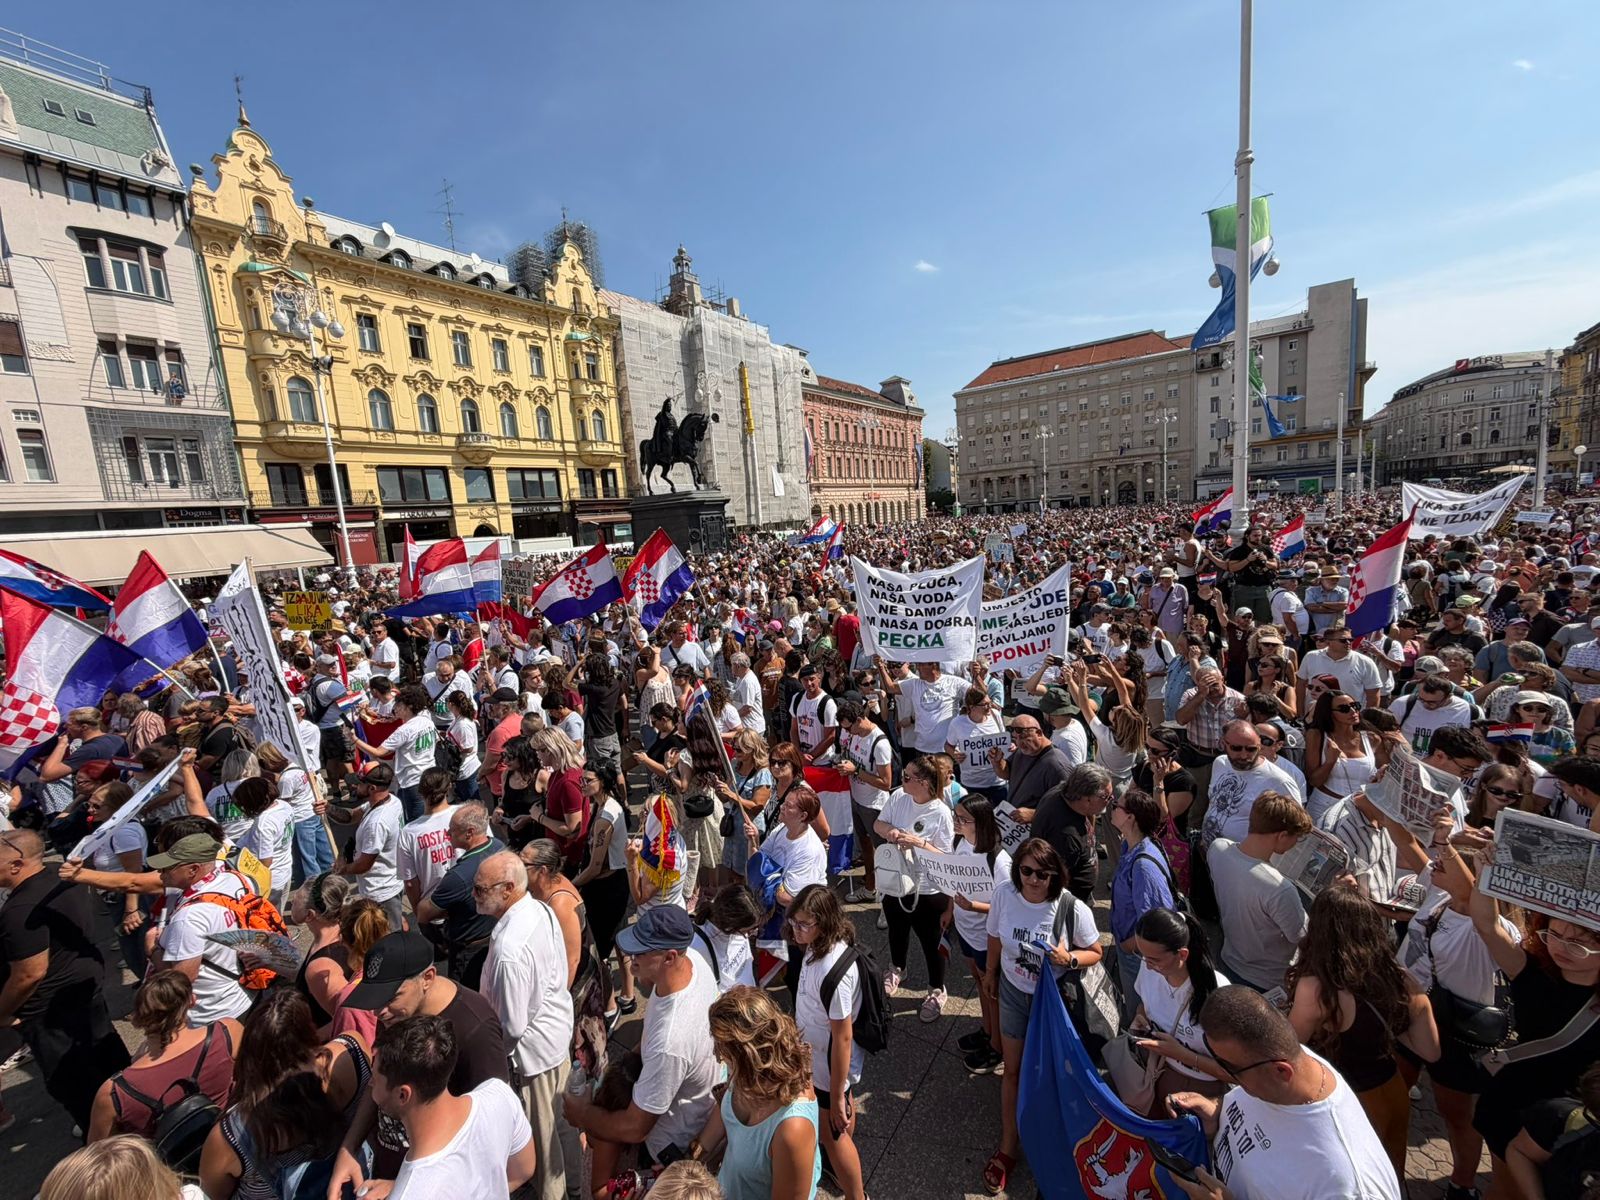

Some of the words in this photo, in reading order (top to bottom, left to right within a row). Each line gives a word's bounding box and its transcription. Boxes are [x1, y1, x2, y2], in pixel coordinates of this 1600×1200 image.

[976, 419, 1038, 435] GRADSKA
[180, 509, 212, 518] Dogma
[1420, 517, 1439, 527] NE
[508, 560, 523, 569] STOP
[870, 588, 907, 604] NAŠA
[296, 604, 323, 616] LIKA
[879, 604, 898, 615] NE
[905, 606, 947, 617] DAMO
[880, 618, 918, 631] NAŠA
[924, 616, 977, 631] DOBRA!
[878, 631, 945, 648] PECKA
[964, 738, 993, 751] Pecka
[995, 736, 1008, 746] uz
[970, 752, 990, 766] Lik
[918, 855, 943, 872] ČISTA
[943, 863, 990, 877] PRIRODA,
[1493, 865, 1524, 884] LIKA
[1526, 876, 1543, 889] JE
[951, 881, 994, 895] SAVJEST!
[1490, 875, 1577, 911] MINISTRICA
[1012, 926, 1031, 944] MIČI
[1226, 1100, 1245, 1135] MIČI
[1236, 1129, 1255, 1159] TO!
